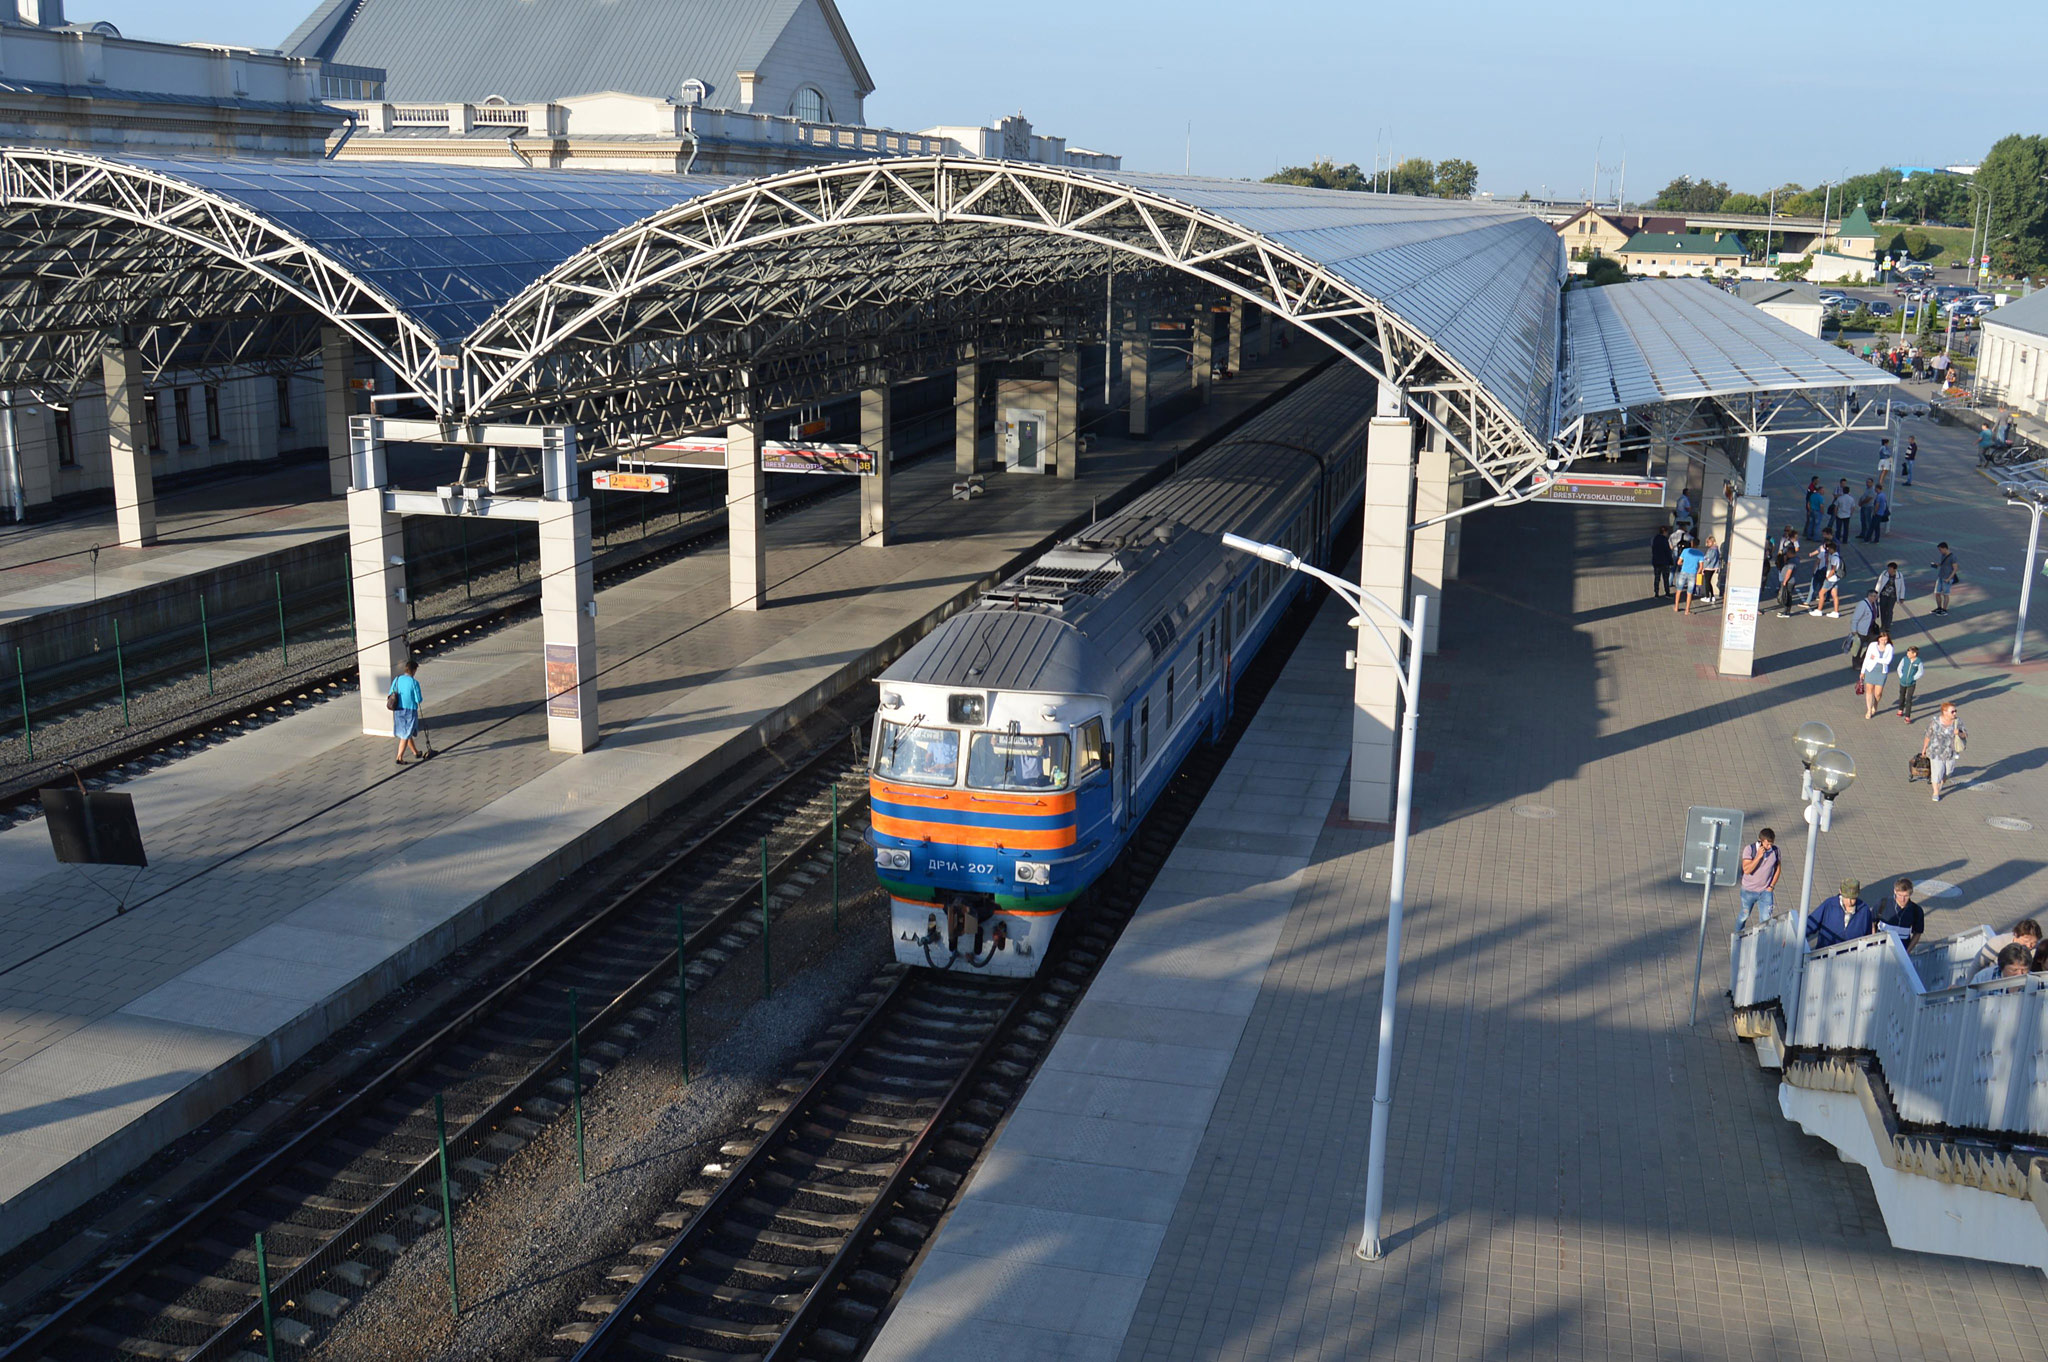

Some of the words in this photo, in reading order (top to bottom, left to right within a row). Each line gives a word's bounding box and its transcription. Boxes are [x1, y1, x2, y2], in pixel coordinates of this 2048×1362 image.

[612, 476, 618, 486] 2
[643, 478, 650, 488] 3
[1738, 613, 1755, 621] 105
